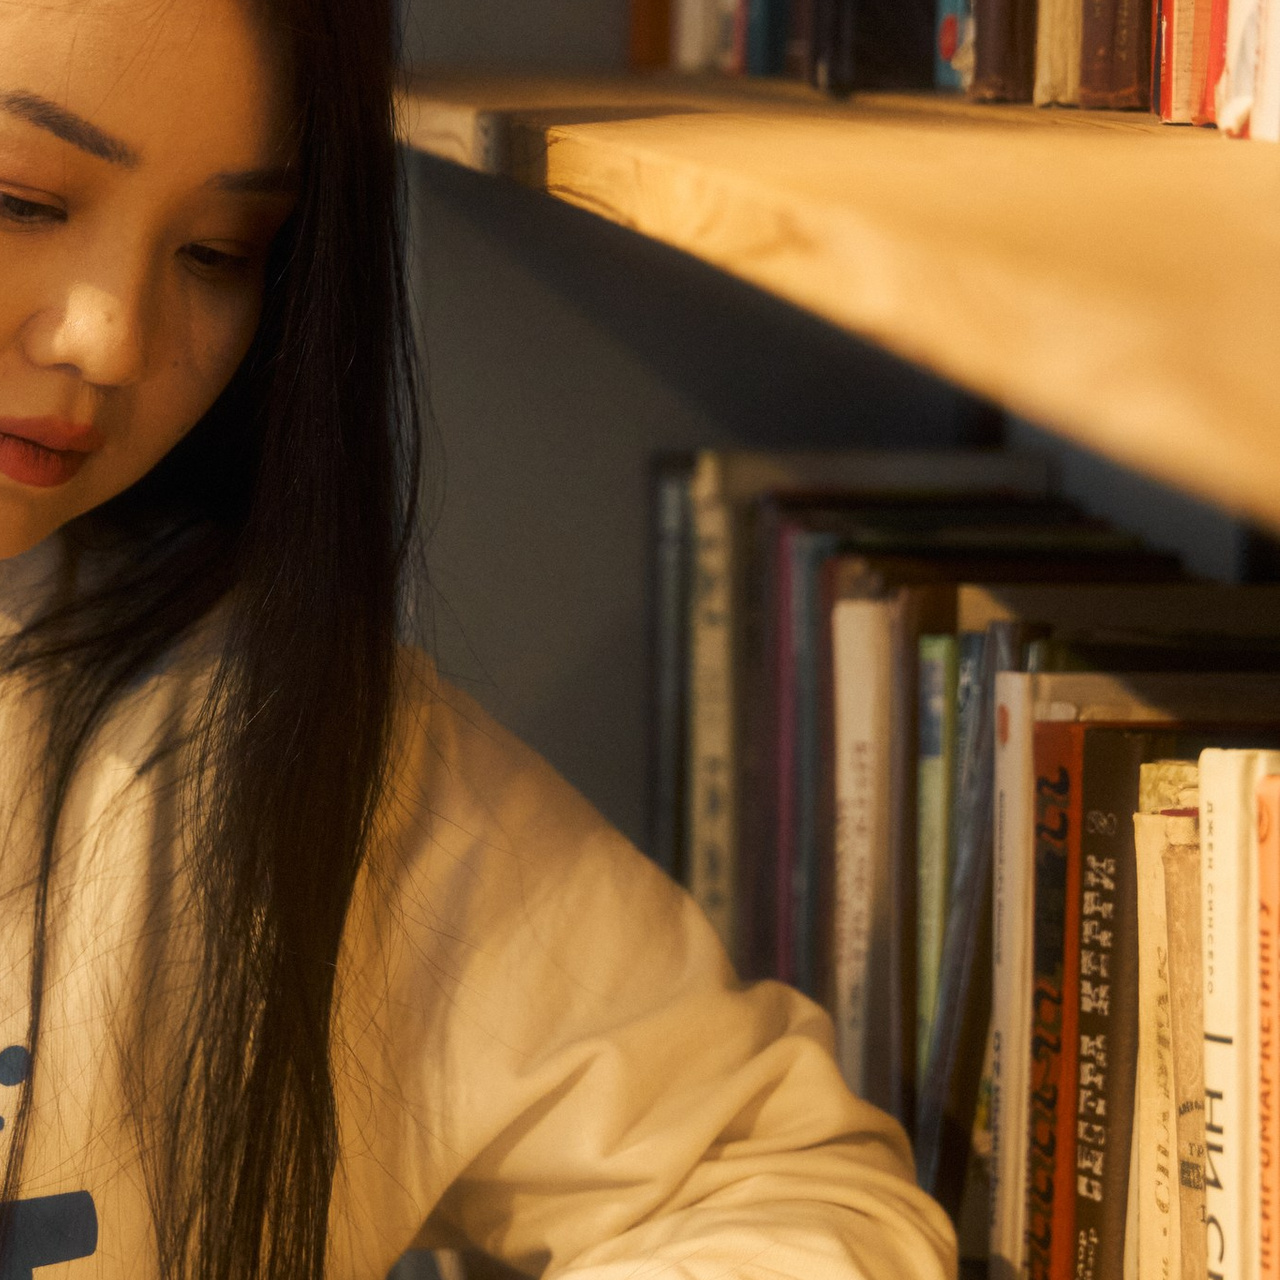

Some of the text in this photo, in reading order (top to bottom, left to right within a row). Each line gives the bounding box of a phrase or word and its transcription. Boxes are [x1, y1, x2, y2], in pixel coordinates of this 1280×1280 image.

[1206, 800, 1215, 995] ДЖЕН СИНСЕРО
[1076, 854, 1116, 1202] СЕСТРА КЕРРИ
[1154, 946, 1170, 1215] СПАРТАК
[1204, 1088, 1224, 1191] НИ
